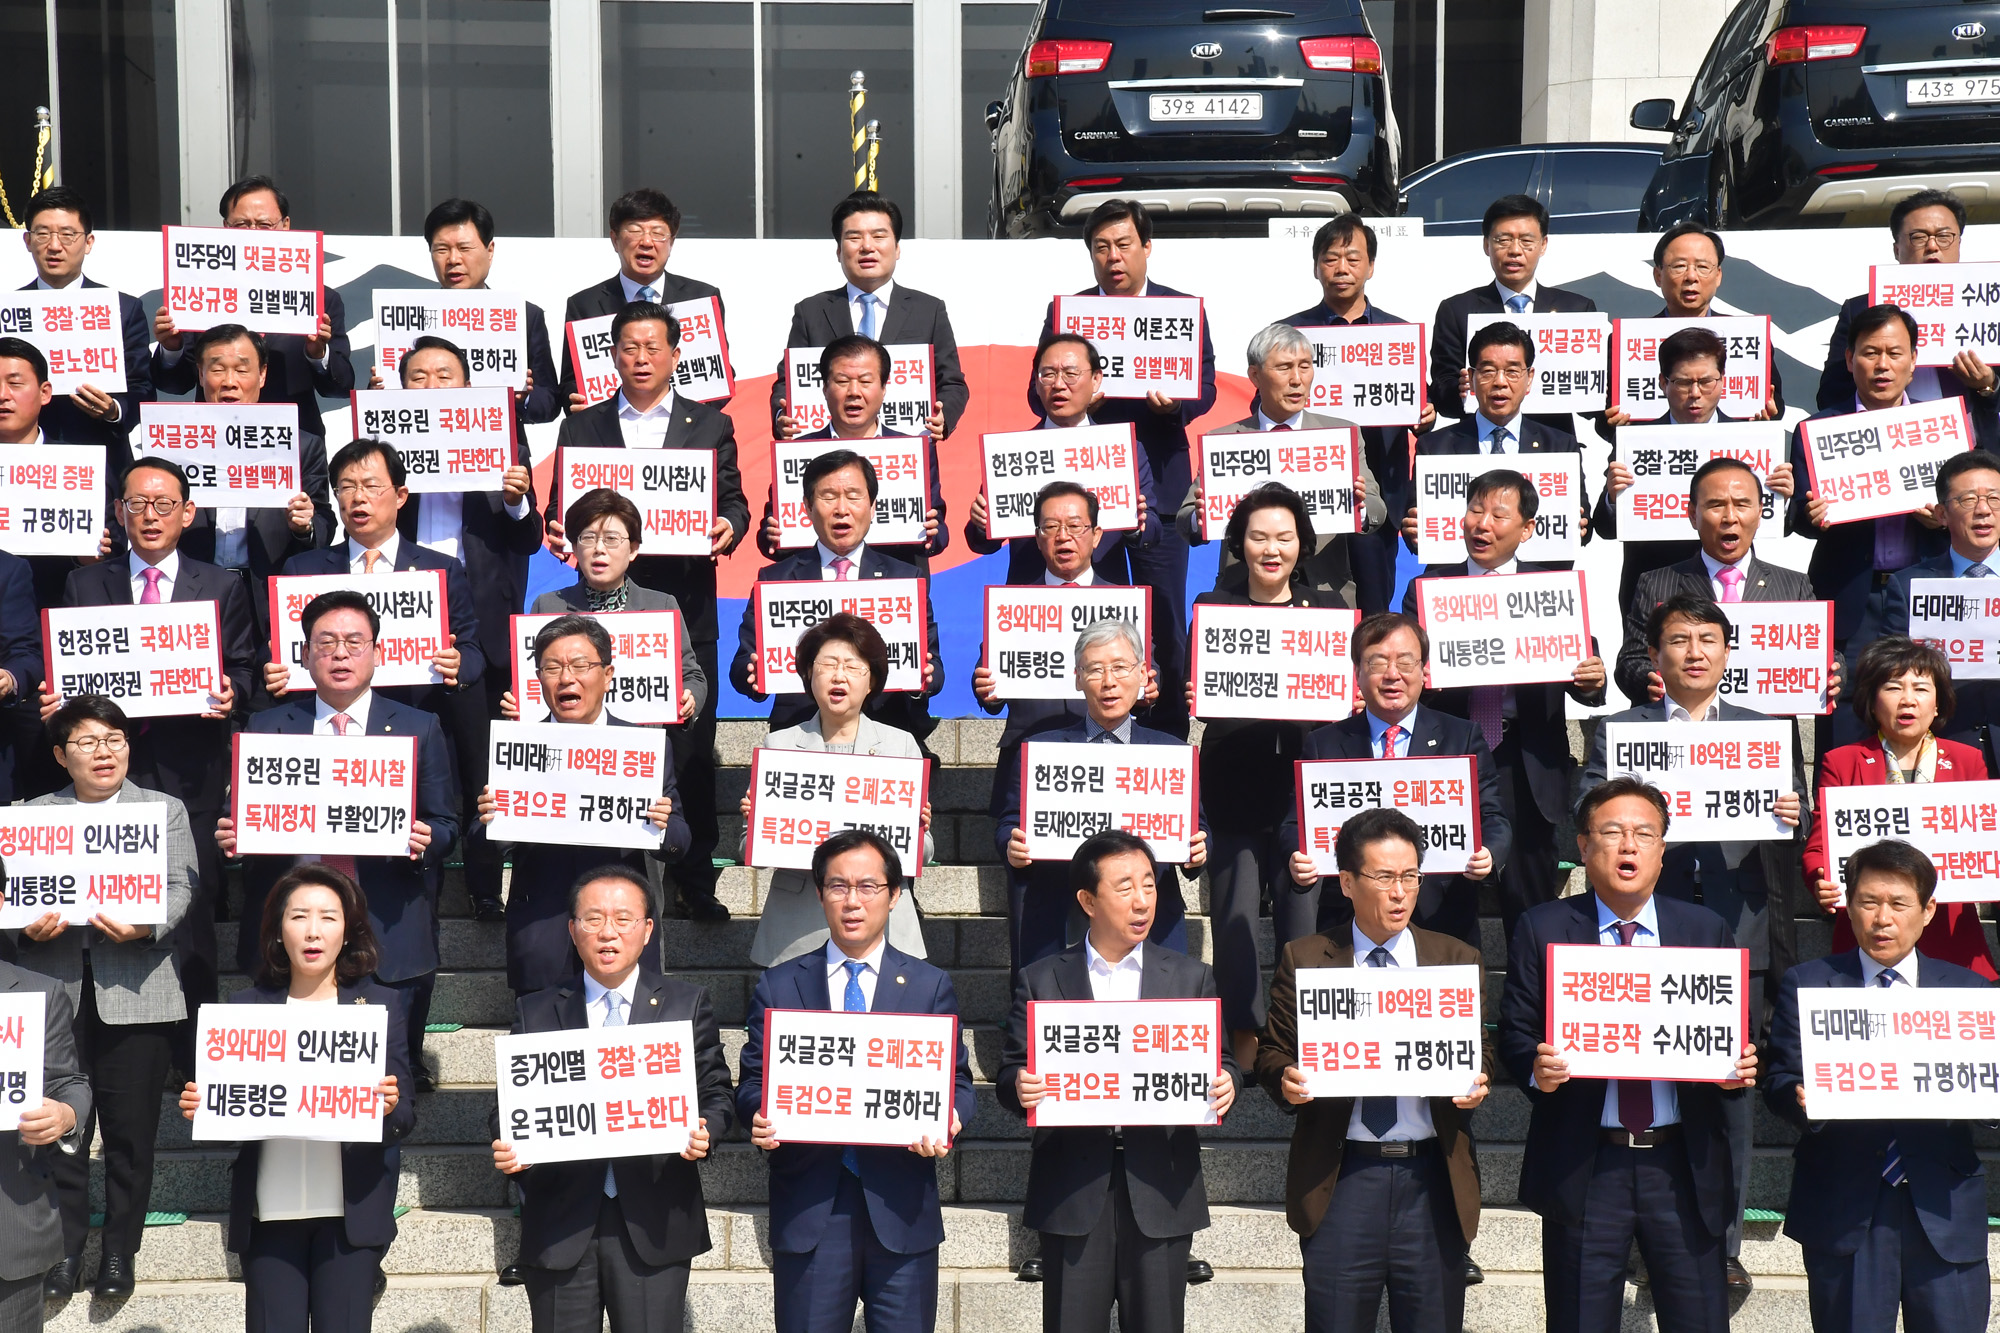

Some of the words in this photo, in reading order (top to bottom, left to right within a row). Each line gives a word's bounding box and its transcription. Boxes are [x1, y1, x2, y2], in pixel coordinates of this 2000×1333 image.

[1955, 25, 1983, 38] KIA
[1194, 44, 1221, 57] KIA
[1205, 99, 1250, 115] 4142
[1074, 131, 1120, 140] CARNIVAL
[1824, 117, 1874, 127] CARNIVAL
[176, 243, 235, 270] 민주당의
[244, 246, 310, 274] 댓글공작
[171, 286, 237, 313] 진상규명
[249, 289, 314, 316] 일벌백계
[1882, 283, 1954, 307] 국정원댓글
[0, 307, 33, 333] 인멸
[443, 308, 484, 331] 18억원
[490, 309, 517, 331] 증발
[1066, 316, 1126, 341] 댓글공작
[1134, 317, 1194, 341] 여론조작
[1342, 343, 1382, 366] 18억원
[1388, 342, 1415, 365] 증발
[1539, 329, 1602, 353] 댓글공작
[50, 348, 117, 374] 분노한다
[459, 345, 517, 373] 명하라
[672, 354, 724, 388] 벌백계
[1134, 357, 1192, 380] 일벌백계
[1354, 383, 1415, 407] 규명하라
[1541, 370, 1604, 395] 일벌백계
[365, 409, 429, 434] 헌정유린
[439, 407, 503, 432] 국회사찰
[880, 399, 931, 426] 벌백계
[149, 425, 216, 449] 댓글공작
[226, 425, 292, 450] 여론조작
[1817, 427, 1881, 460] 민주당의
[1887, 414, 1958, 449] 댓글공작
[448, 448, 505, 473] 규탄한다
[992, 450, 1055, 477] 헌정유린
[1065, 444, 1126, 472] 국회사찰
[1211, 449, 1270, 477] 민주당의
[1279, 445, 1345, 473] 댓글공작
[10, 465, 56, 489] 18억원
[63, 466, 94, 490] 증발
[227, 465, 292, 489] 일벌백계
[571, 463, 634, 491] 청와대의
[643, 465, 706, 492] 인사참사
[1538, 472, 1569, 498] 증발
[1820, 468, 1892, 505] 진상규명
[875, 495, 924, 524] 벌백계
[1300, 487, 1352, 515] 벌백계
[1633, 493, 1690, 520] 특검으로
[23, 508, 92, 534] 규명하라
[644, 509, 709, 537] 사과하라
[769, 599, 832, 628] 민주당의
[997, 605, 1062, 632] 청와대의
[1432, 594, 1498, 622] 청와대의
[1507, 590, 1574, 618] 인사참사
[58, 627, 129, 656] 헌정유린
[141, 623, 210, 652] 국회사찰
[1205, 627, 1270, 654] 헌정유린
[1281, 630, 1347, 656] 국회사찰
[1439, 638, 1505, 667] 대통령은
[1514, 634, 1581, 663] 사과하라
[1751, 624, 1820, 650] 국회사찰
[1000, 651, 1065, 678] 대통령은
[61, 671, 142, 699] 문재인정권
[150, 667, 213, 695] 규탄한다
[1204, 672, 1278, 698] 문재인정권
[1286, 674, 1346, 700] 규탄한다
[1757, 667, 1820, 694] 규탄한다
[568, 748, 617, 776] 18억원
[623, 751, 656, 778] 증발
[1690, 742, 1740, 770] 18억원
[1747, 741, 1781, 769] 증발
[247, 757, 320, 785] 헌정유린
[332, 759, 405, 787] 국회사찰
[1035, 764, 1103, 793] 헌정유린
[1116, 767, 1185, 795] 국회사찰
[765, 771, 835, 802] 댓글공작
[845, 777, 915, 808] 은폐조작
[1311, 781, 1382, 809] 댓글공작
[1393, 780, 1464, 806] 은폐조작
[246, 804, 315, 832] 독재정치
[327, 805, 405, 834] 부활인가?
[495, 789, 566, 819] 특검으로
[579, 793, 651, 824] 규명하라
[1835, 807, 1910, 836] 헌정유린
[1922, 804, 1997, 833] 국회사찰
[0, 826, 73, 856] 청와대의
[84, 824, 159, 854] 인사참사
[1421, 823, 1467, 852] 명하라
[3, 875, 76, 906] 대통령은
[87, 874, 162, 904] 사과하라
[1378, 989, 1432, 1018] 18억원
[1439, 988, 1474, 1018] 증발
[1563, 972, 1651, 1002] 국정원댓글
[1661, 974, 1732, 1005] 수사하듯
[1044, 1025, 1120, 1053] 댓글공작
[1133, 1025, 1209, 1053] 은폐조작
[1563, 1023, 1641, 1054] 댓글공작
[1654, 1025, 1733, 1056] 수사하라
[1893, 1011, 1951, 1040] 18억원
[1958, 1011, 1995, 1040] 증발
[206, 1028, 286, 1062] 청와대의
[298, 1030, 378, 1064] 인사참사
[779, 1035, 856, 1067] 댓글공작
[867, 1038, 944, 1071] 은폐조작
[1302, 1042, 1381, 1072] 특검으로
[1395, 1040, 1475, 1071] 규명하라
[511, 1050, 586, 1086] 증거인멸
[1815, 1063, 1899, 1092] 특검으로
[1912, 1061, 2000, 1094] 규명하라
[207, 1084, 287, 1117] 대통령은
[297, 1084, 380, 1119] 사과하라
[1045, 1072, 1120, 1102] 특검으로
[1132, 1072, 1210, 1102] 규명하라
[606, 1096, 688, 1132] 분노한다
[776, 1085, 851, 1115] 특검으로
[865, 1089, 941, 1121] 규명하라
